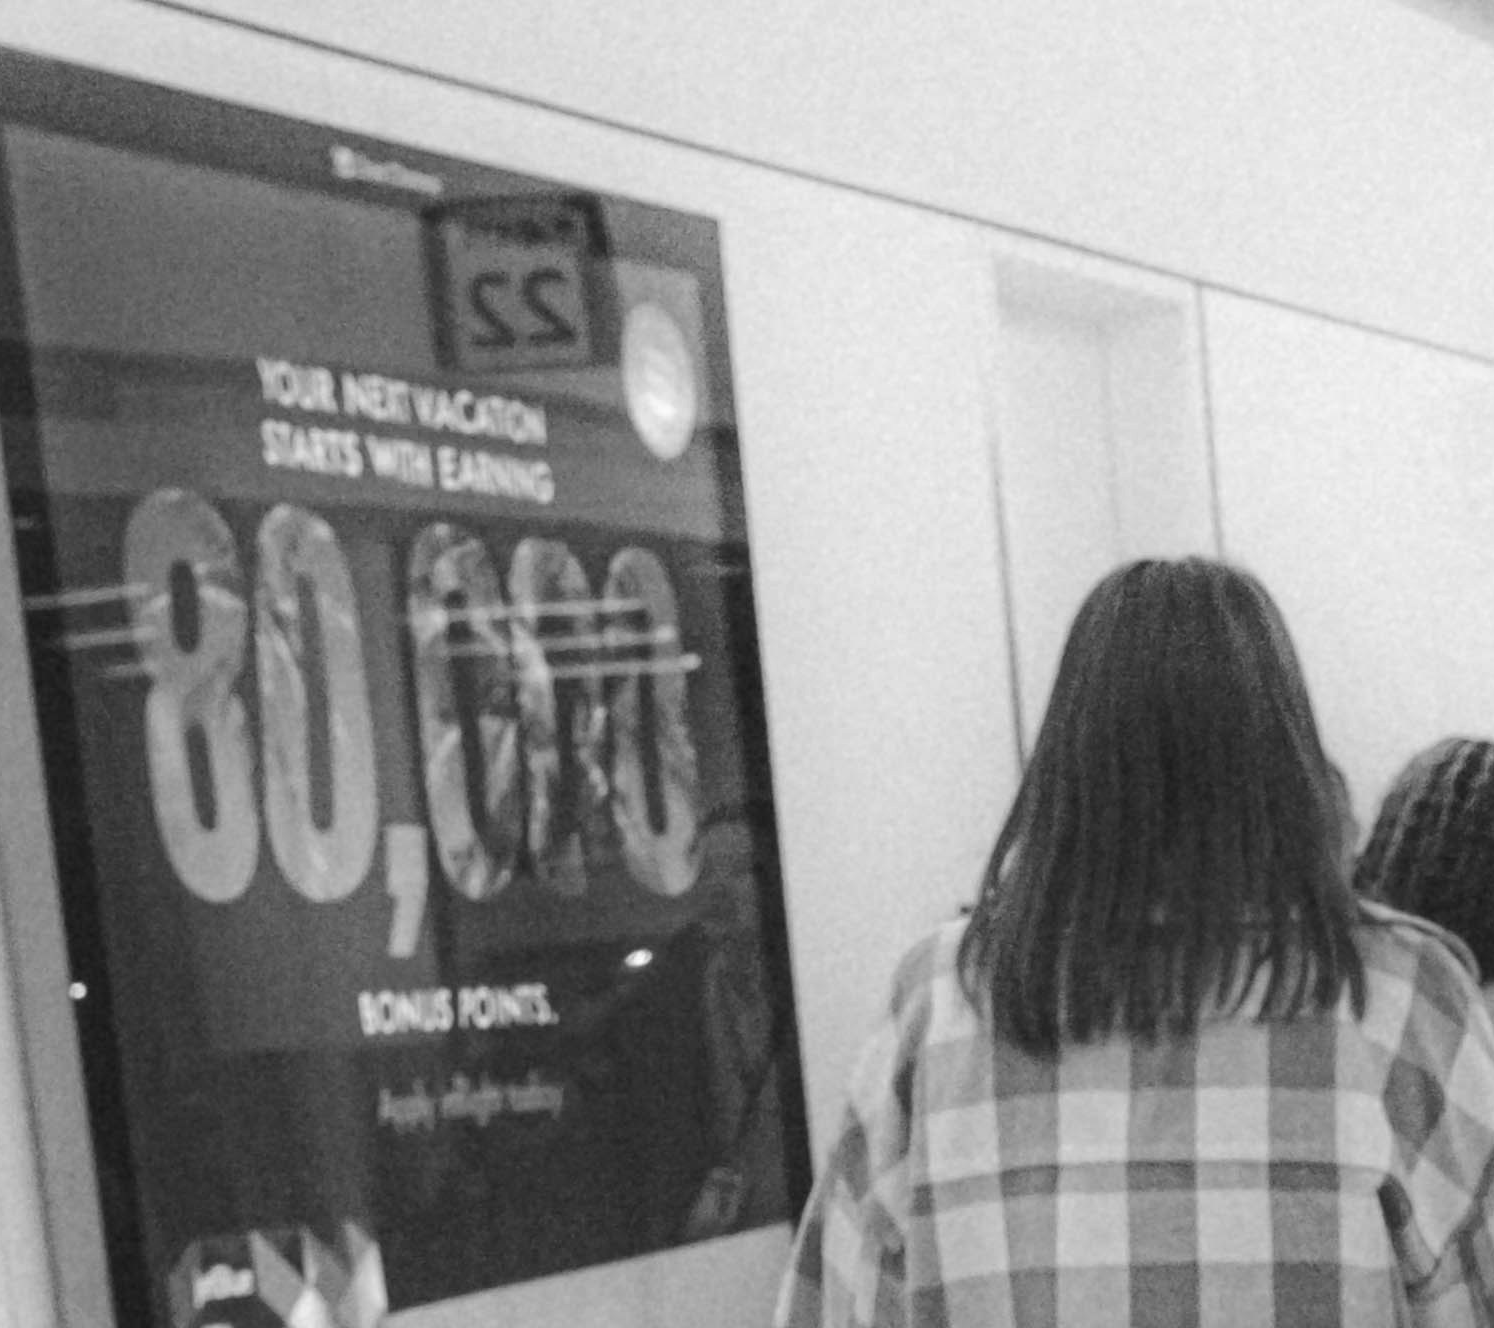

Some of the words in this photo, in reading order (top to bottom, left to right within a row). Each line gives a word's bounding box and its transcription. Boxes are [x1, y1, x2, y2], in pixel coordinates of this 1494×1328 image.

[256, 357, 338, 414] YOUR
[341, 372, 413, 424] NEXT
[411, 386, 547, 446] VACATION
[260, 418, 363, 478] STARTS
[365, 433, 434, 488] WITH
[437, 444, 555, 504] EARNING
[122, 486, 701, 958] 80,000
[358, 986, 455, 1036] BONUS
[458, 982, 561, 1030] POINTS.
